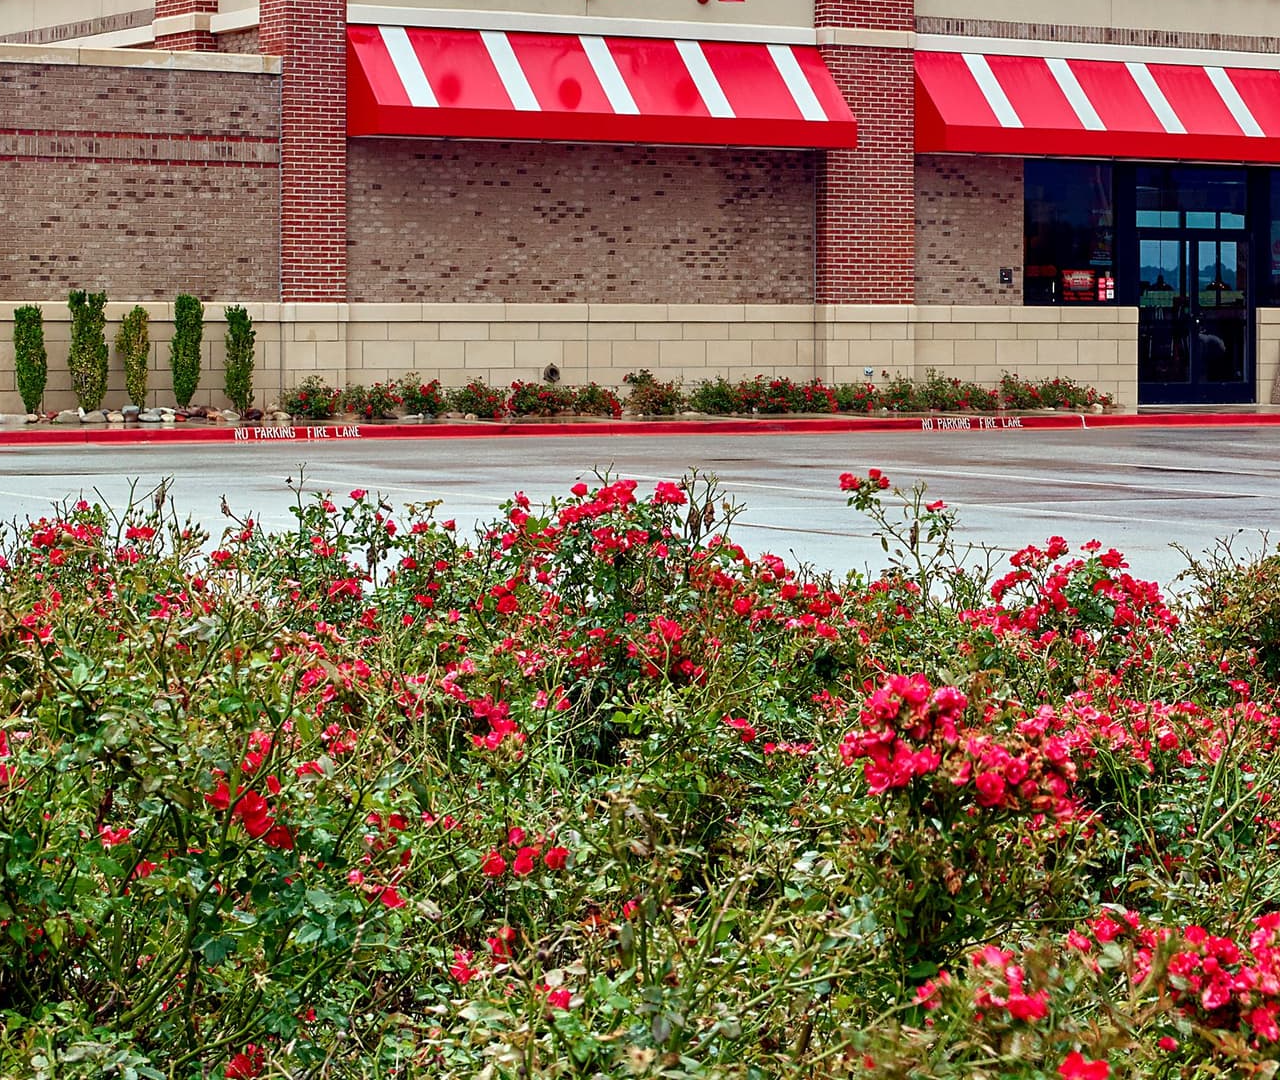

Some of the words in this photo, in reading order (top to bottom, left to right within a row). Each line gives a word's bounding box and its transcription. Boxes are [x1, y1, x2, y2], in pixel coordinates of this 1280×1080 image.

[921, 418, 933, 430] NO
[937, 417, 970, 430] PARKING
[979, 416, 998, 429] FIRE
[1001, 416, 1023, 428] LANE
[234, 427, 248, 440] NO
[254, 426, 296, 439] PARKING
[307, 425, 330, 438] FIRE
[335, 425, 362, 438] LANE
